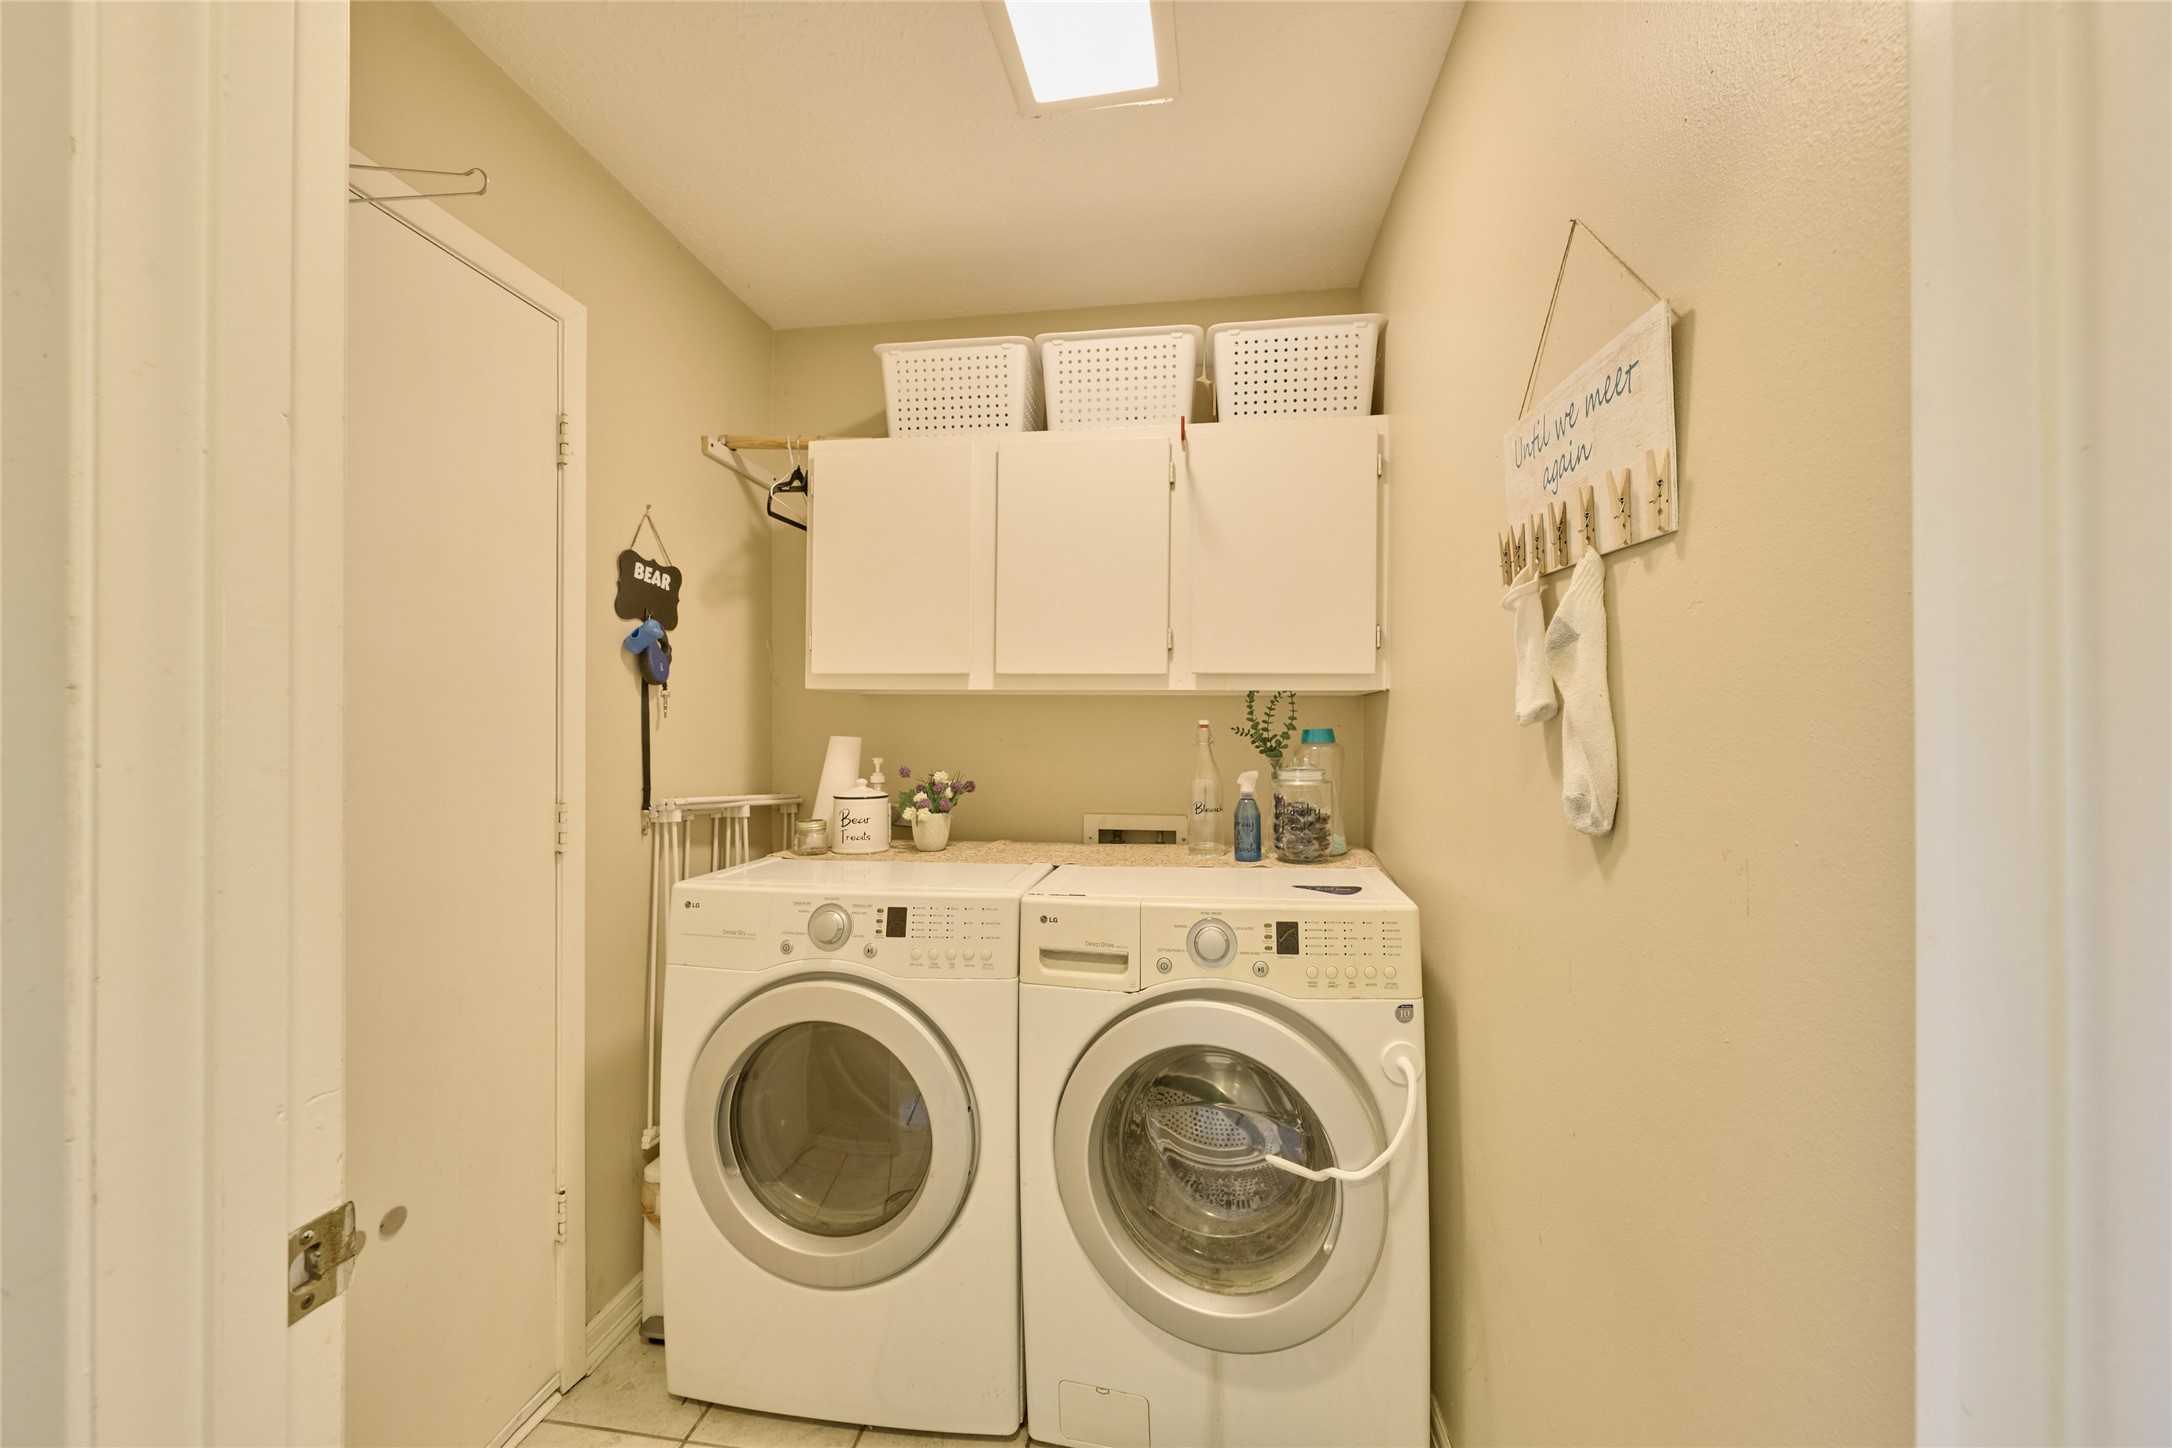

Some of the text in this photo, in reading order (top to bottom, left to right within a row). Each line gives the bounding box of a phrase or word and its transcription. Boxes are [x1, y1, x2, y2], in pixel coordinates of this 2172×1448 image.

[1514, 359, 1640, 469] Until we meet
[1542, 439, 1594, 496] again
[633, 561, 671, 591] BEAR
[1192, 801, 1224, 815] Bleach
[839, 808, 872, 828] Bear
[840, 829, 872, 844] Treats
[1085, 940, 1100, 948] Direct
[1101, 941, 1114, 949] Drive
[1400, 1009, 1410, 1018] 10
